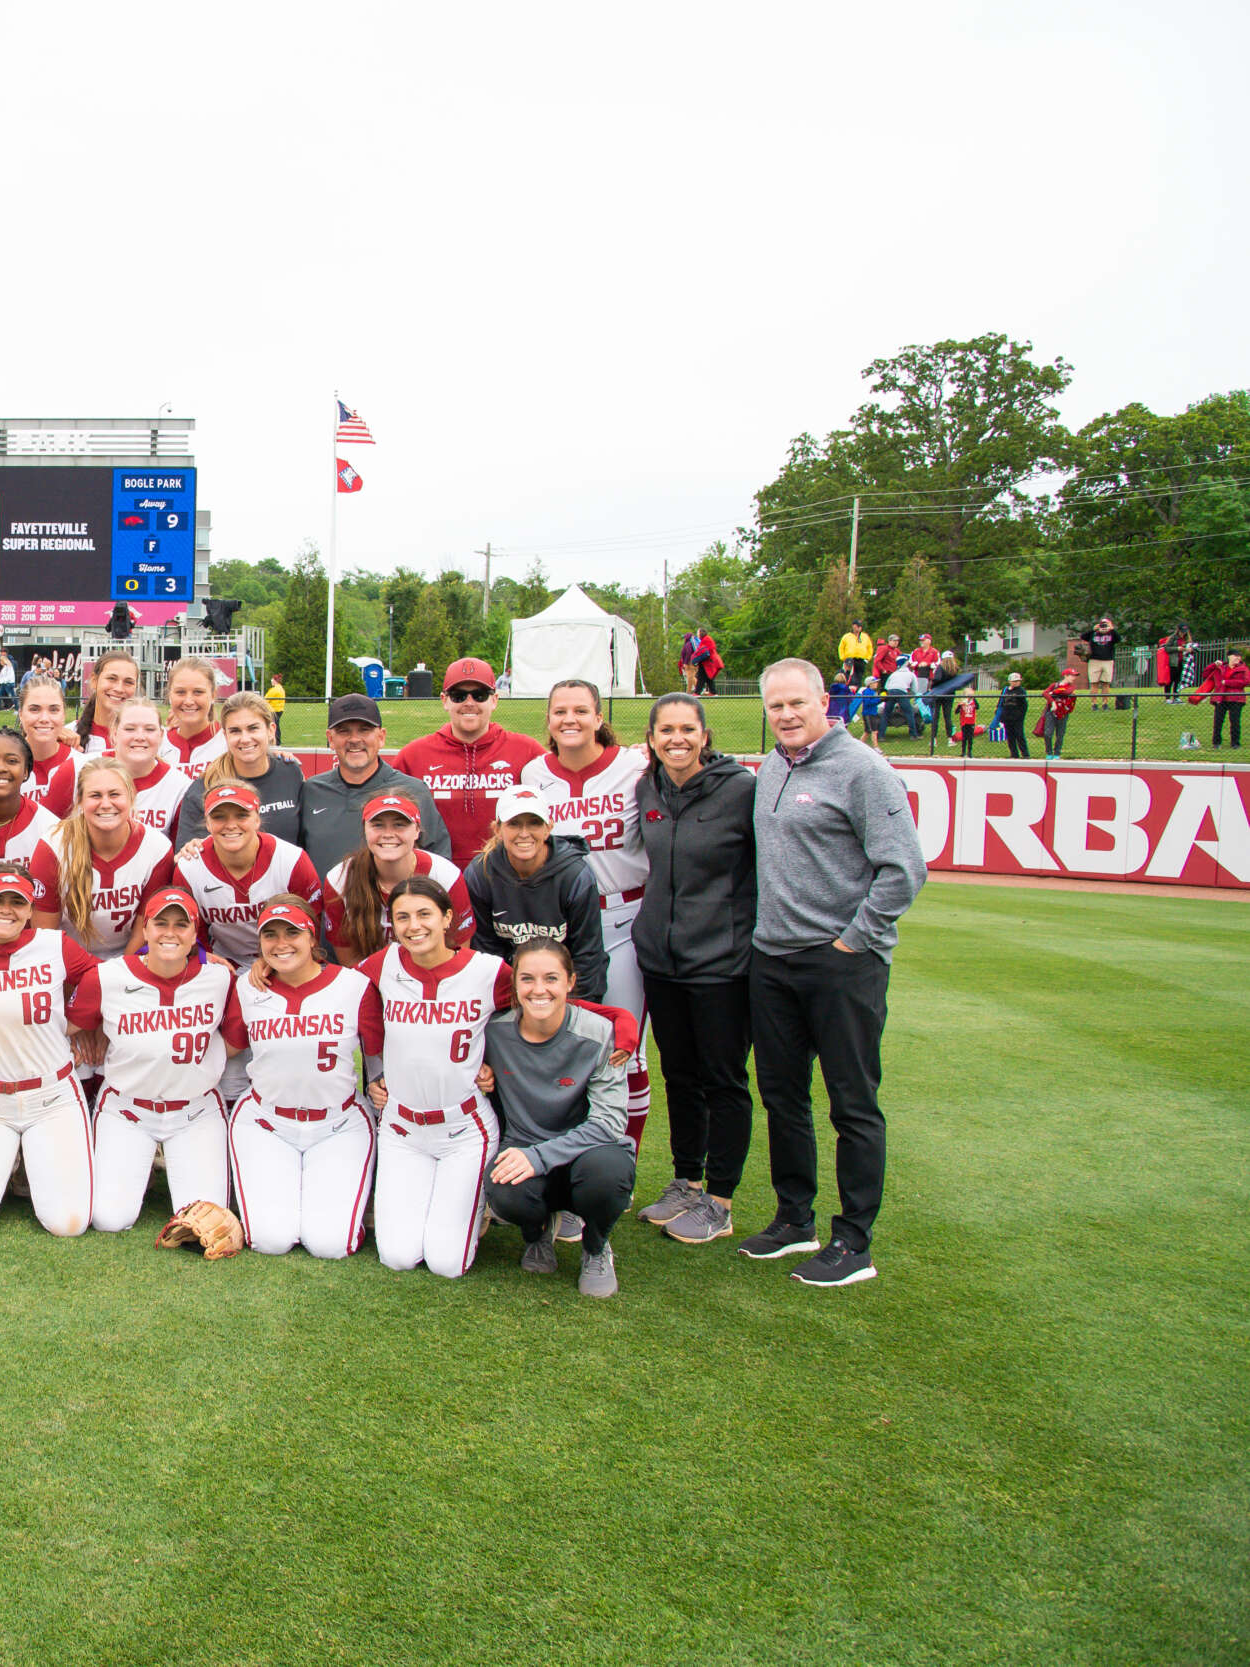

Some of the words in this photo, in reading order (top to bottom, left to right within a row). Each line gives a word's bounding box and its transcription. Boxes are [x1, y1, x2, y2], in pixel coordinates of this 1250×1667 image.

[124, 478, 154, 489] BOGLE
[157, 478, 182, 489] PARK
[10, 522, 88, 535] FAYETTEVILLE
[166, 514, 179, 528] 9
[2, 538, 38, 551] SUPER
[41, 538, 96, 551] REGIONAL
[148, 541, 157, 552] F
[165, 578, 177, 593] 3
[423, 773, 514, 790] RAZORBACKS
[548, 793, 624, 824] RKANSAS
[581, 817, 625, 852] 22
[21, 991, 52, 1026] 18
[117, 1003, 214, 1036] ARKANSAS
[384, 999, 482, 1025] ARKANSAS
[250, 1013, 344, 1042] ARKANSAS
[171, 1031, 211, 1065] 99
[316, 1041, 338, 1073] 5
[449, 1029, 473, 1064] 6
